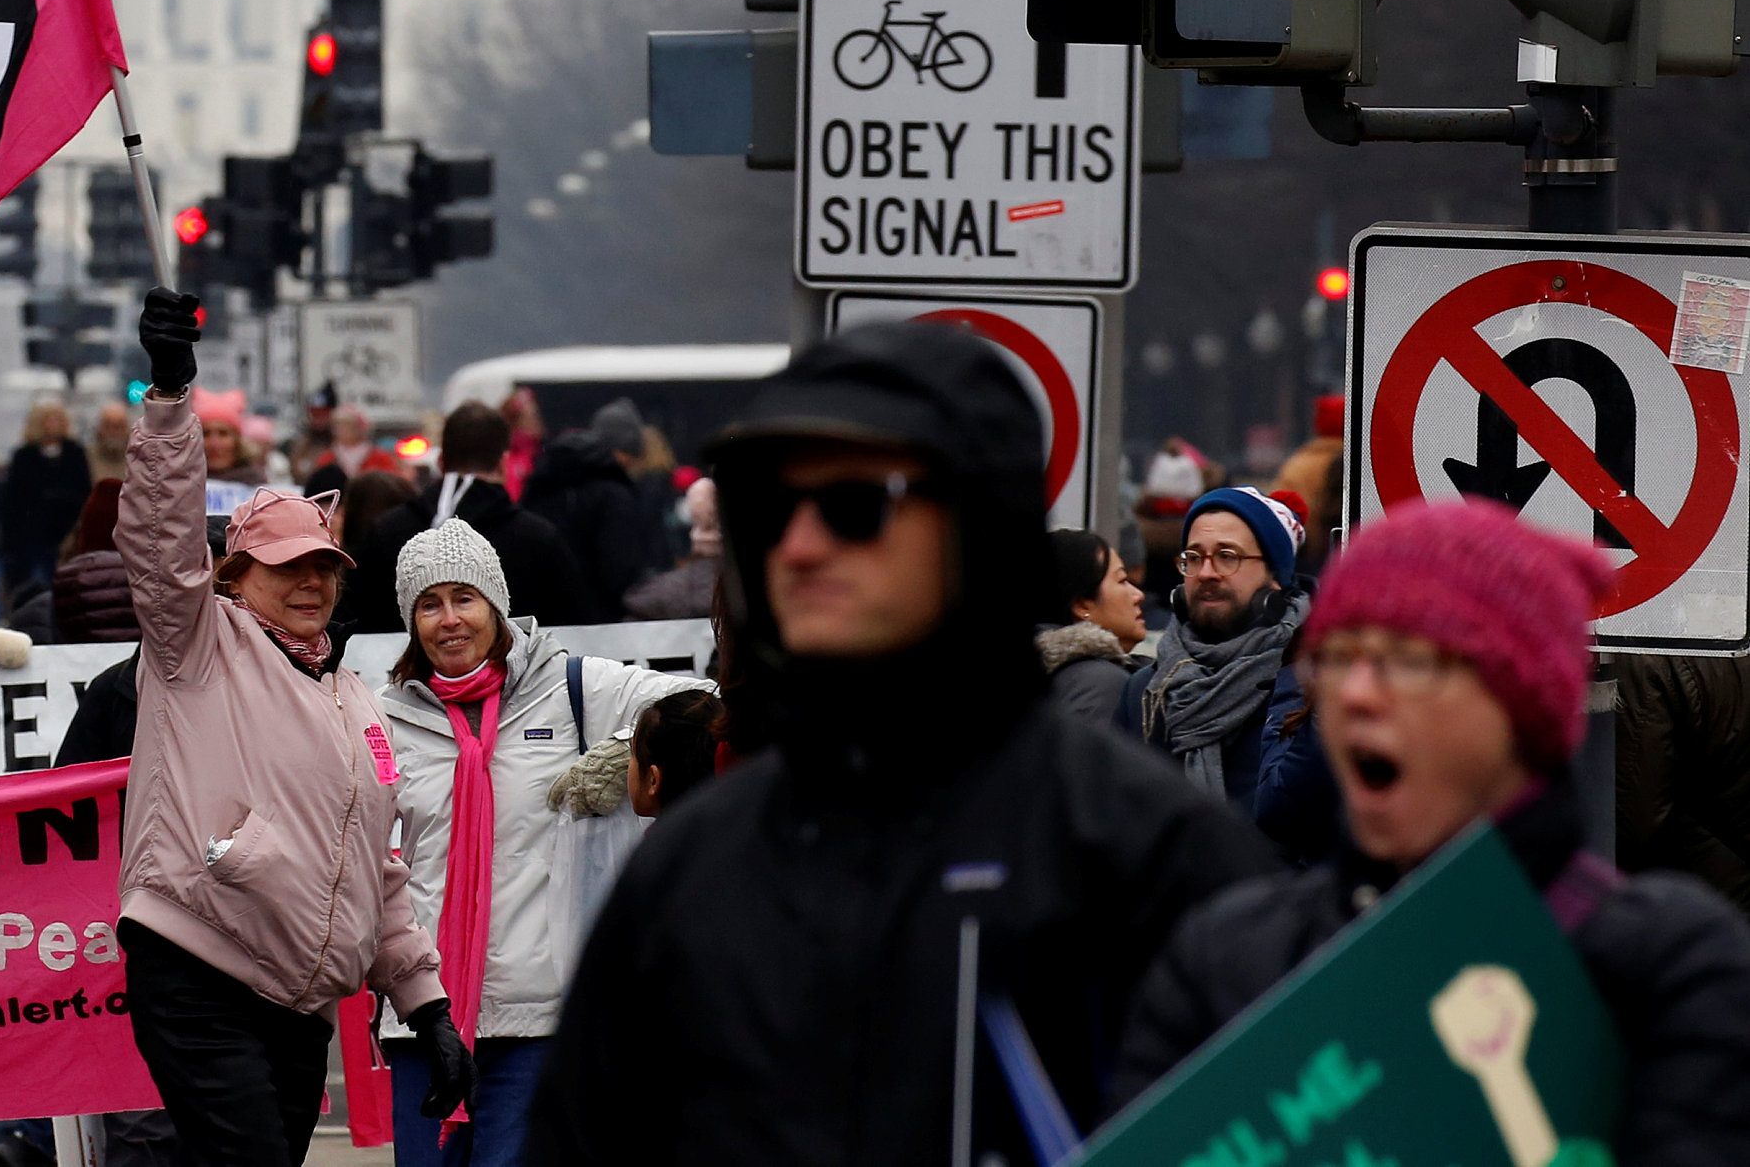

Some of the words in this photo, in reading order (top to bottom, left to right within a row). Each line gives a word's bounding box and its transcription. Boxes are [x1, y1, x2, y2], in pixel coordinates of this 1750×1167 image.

[821, 119, 968, 180] OBEY
[994, 123, 1114, 184] THIS
[819, 196, 1017, 258] SIGNAL
[369, 739, 389, 749] LOVE
